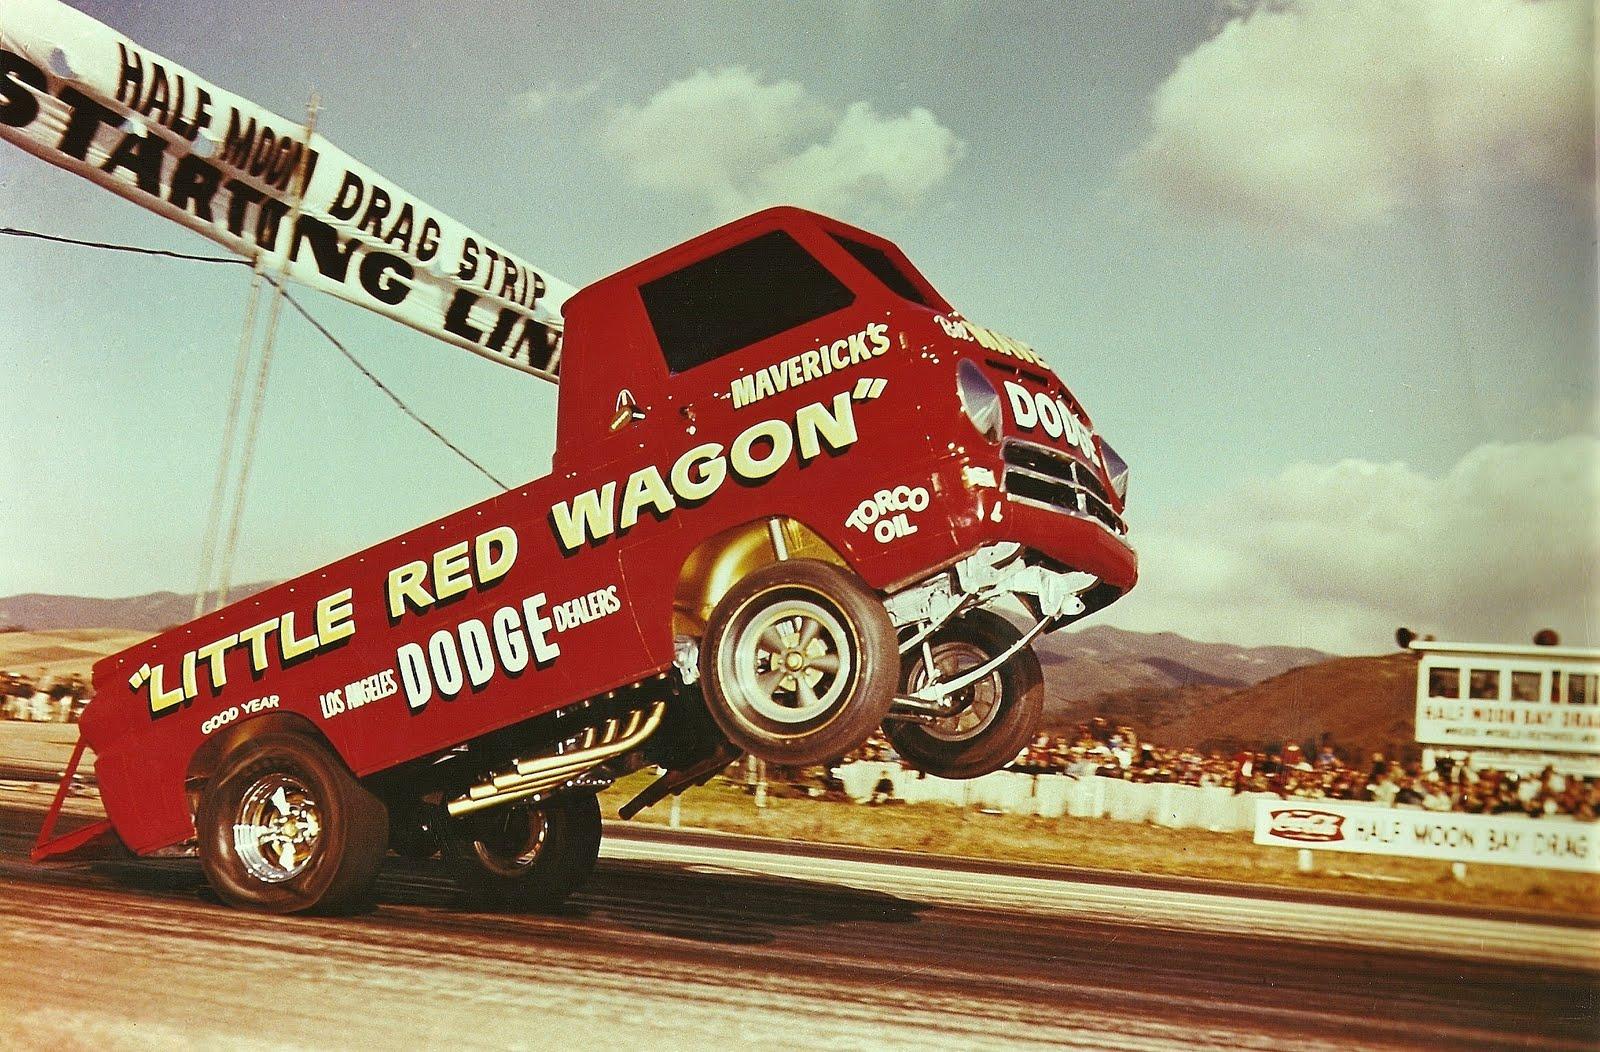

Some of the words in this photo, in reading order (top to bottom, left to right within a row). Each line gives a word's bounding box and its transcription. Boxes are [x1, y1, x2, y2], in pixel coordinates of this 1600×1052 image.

[116, 42, 213, 141] HALF
[221, 107, 319, 200] MOON
[328, 170, 441, 261] DRAG
[457, 237, 546, 309] STRIP
[444, 287, 562, 374] LIN
[730, 323, 890, 409] MAVERICK'S
[845, 485, 930, 534] TORCO
[874, 513, 918, 544] OIL
[388, 526, 518, 618] RED
[319, 689, 346, 719] LOS
[344, 669, 398, 710] ANGELES
[397, 592, 561, 709] DODGE
[552, 585, 621, 633] DEALERS
[201, 706, 239, 735] GOOD
[240, 695, 280, 714] YEAR
